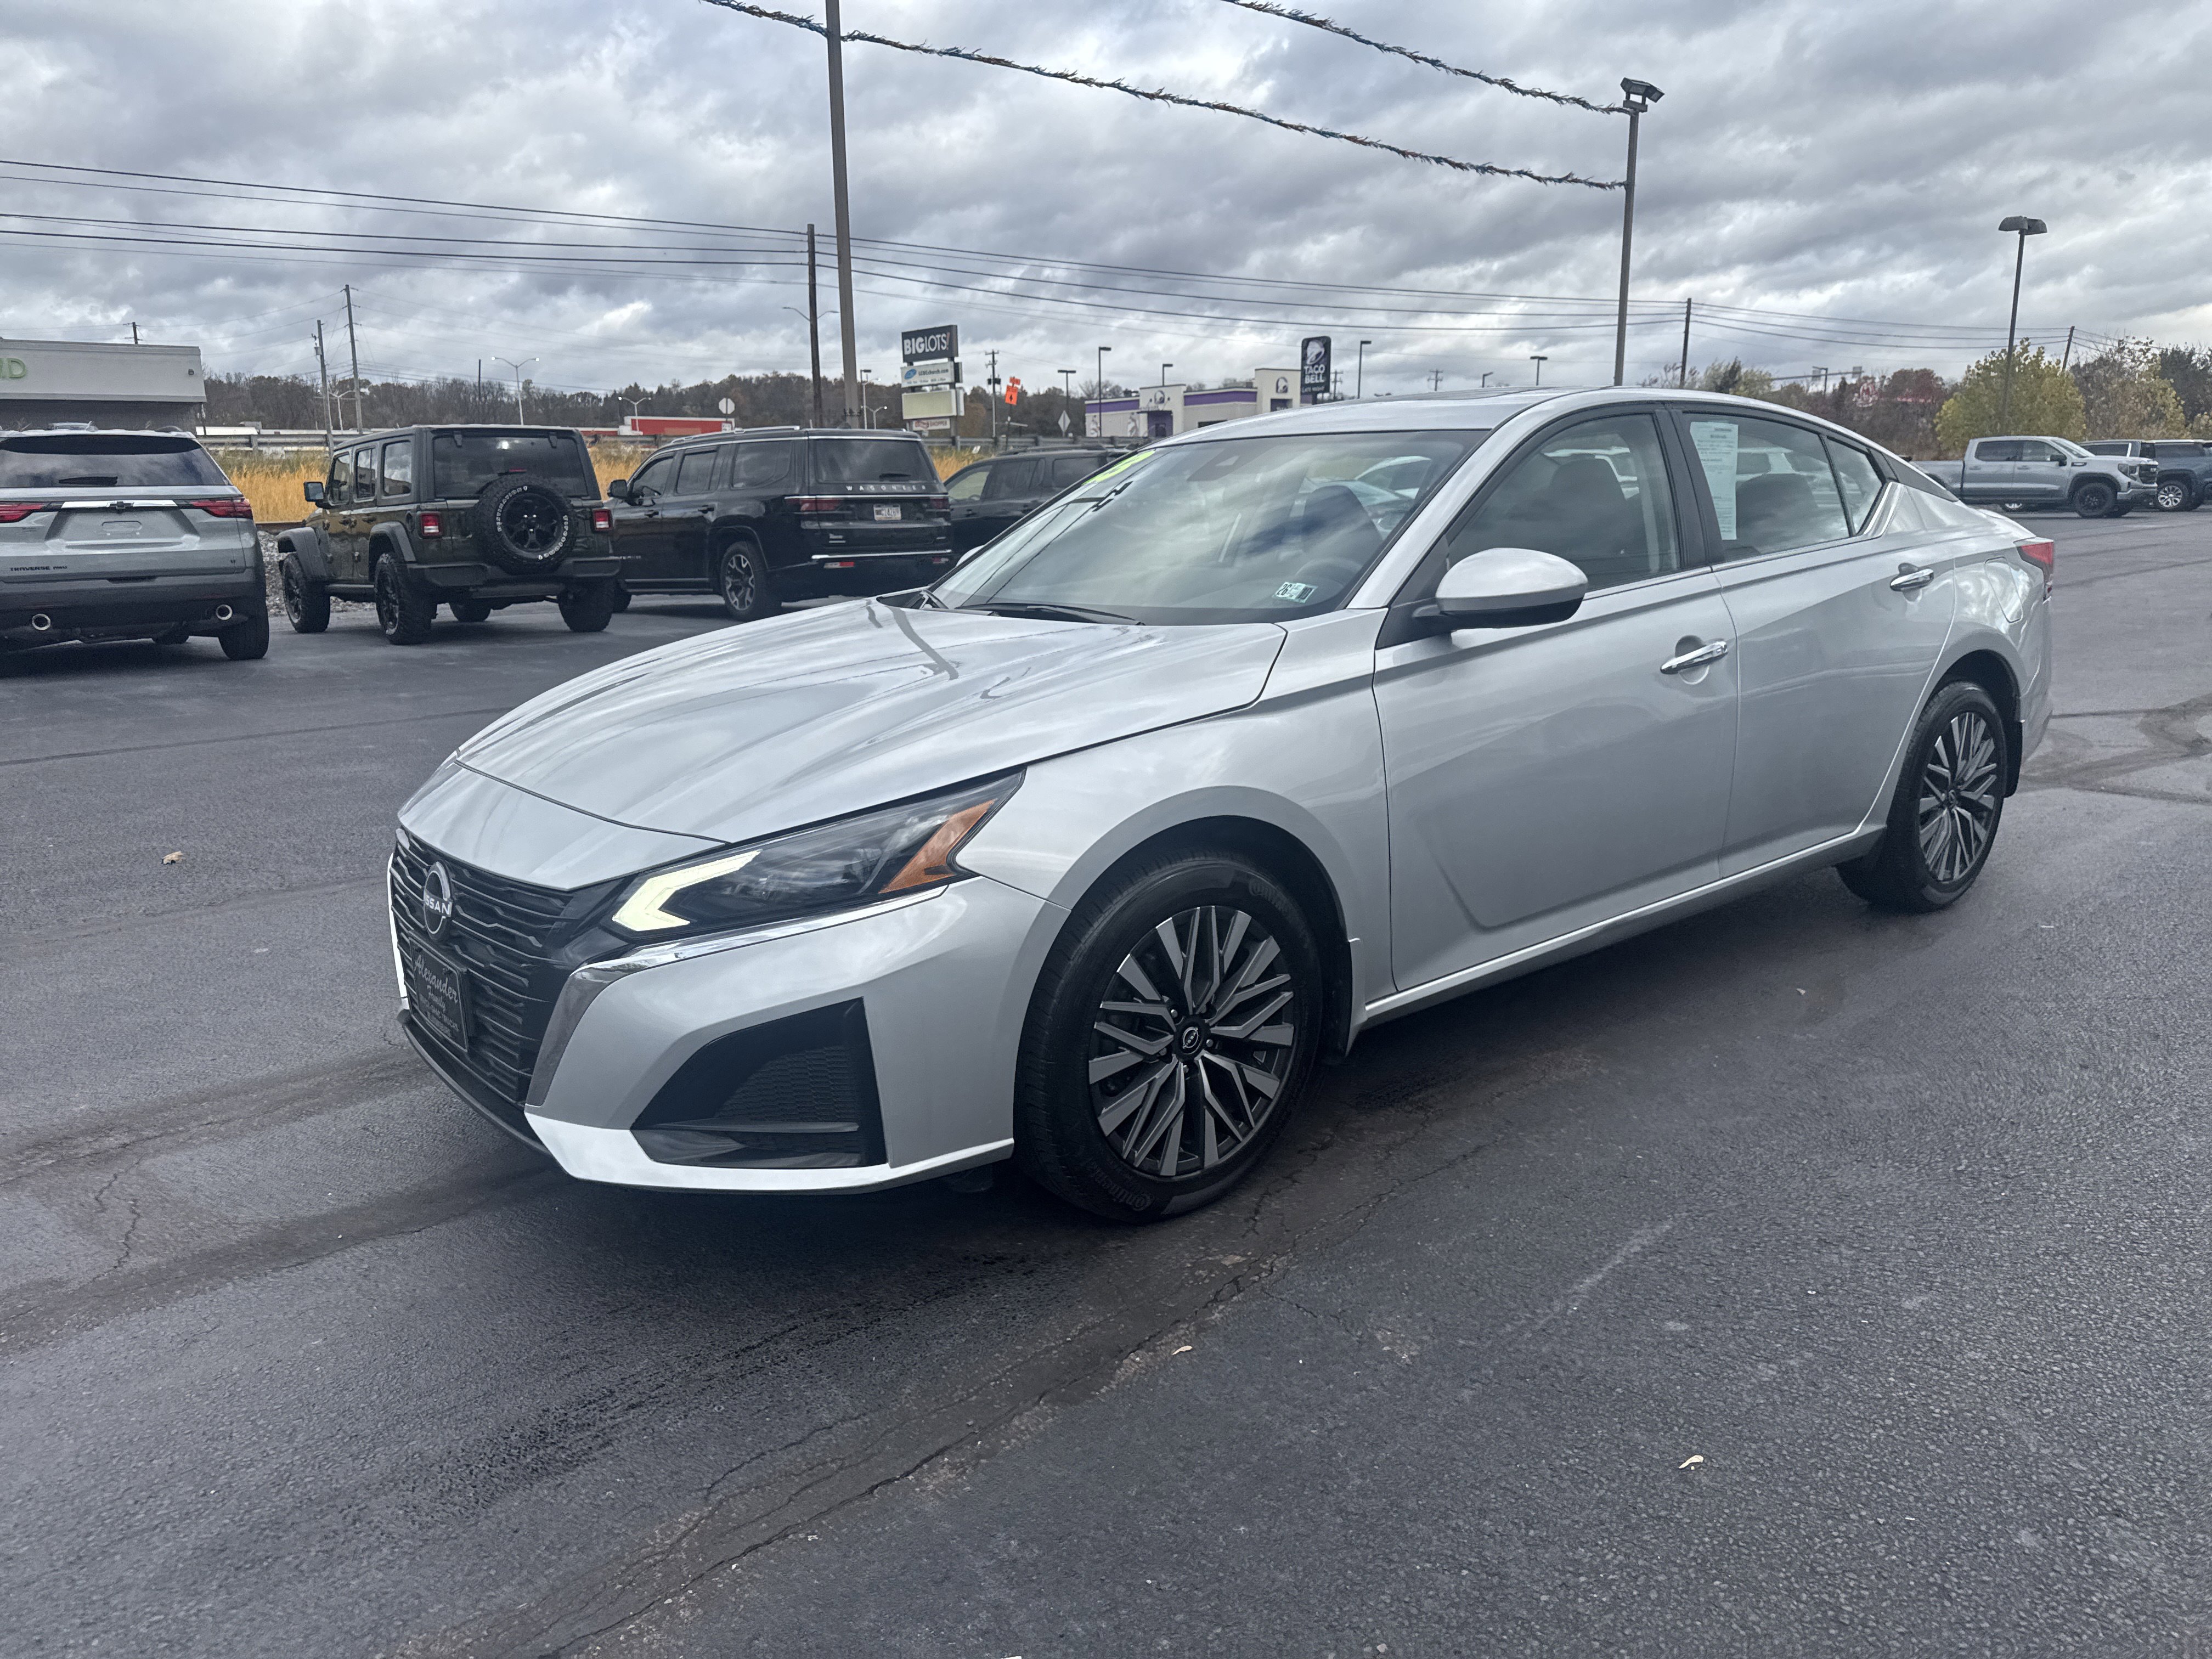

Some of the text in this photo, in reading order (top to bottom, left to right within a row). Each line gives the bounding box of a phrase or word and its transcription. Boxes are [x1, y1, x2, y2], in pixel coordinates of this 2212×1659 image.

[1304, 364, 1325, 374] TACO
[1305, 374, 1324, 384] BELL
[414, 955, 458, 1003] Alexander
